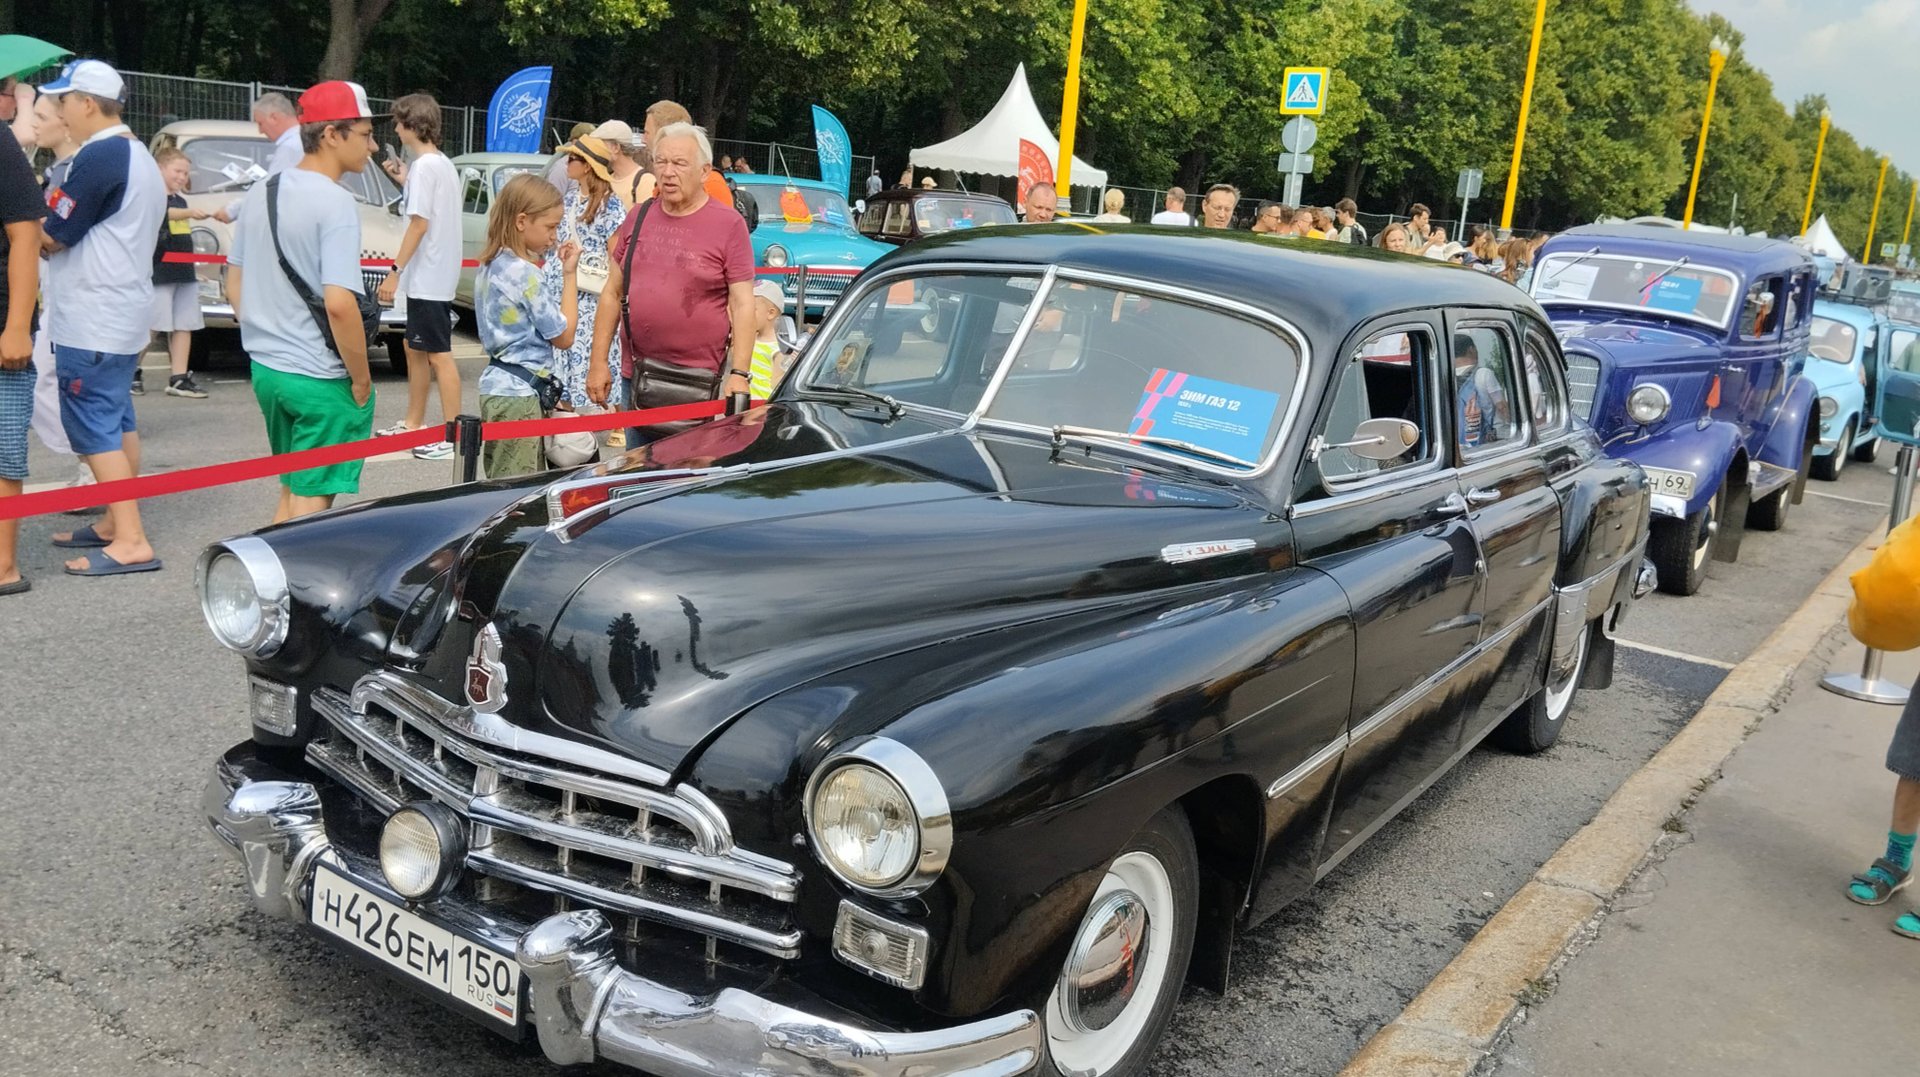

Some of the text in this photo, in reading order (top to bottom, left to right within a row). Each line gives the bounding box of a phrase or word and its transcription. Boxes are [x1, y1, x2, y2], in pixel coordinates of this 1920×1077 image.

[1180, 390, 1206, 404] ЗИМ
[1205, 397, 1225, 408] ГАЗ
[1227, 400, 1241, 411] 12
[1665, 475, 1685, 489] 69
[458, 945, 511, 997] 150
[467, 984, 494, 1007] RUS
